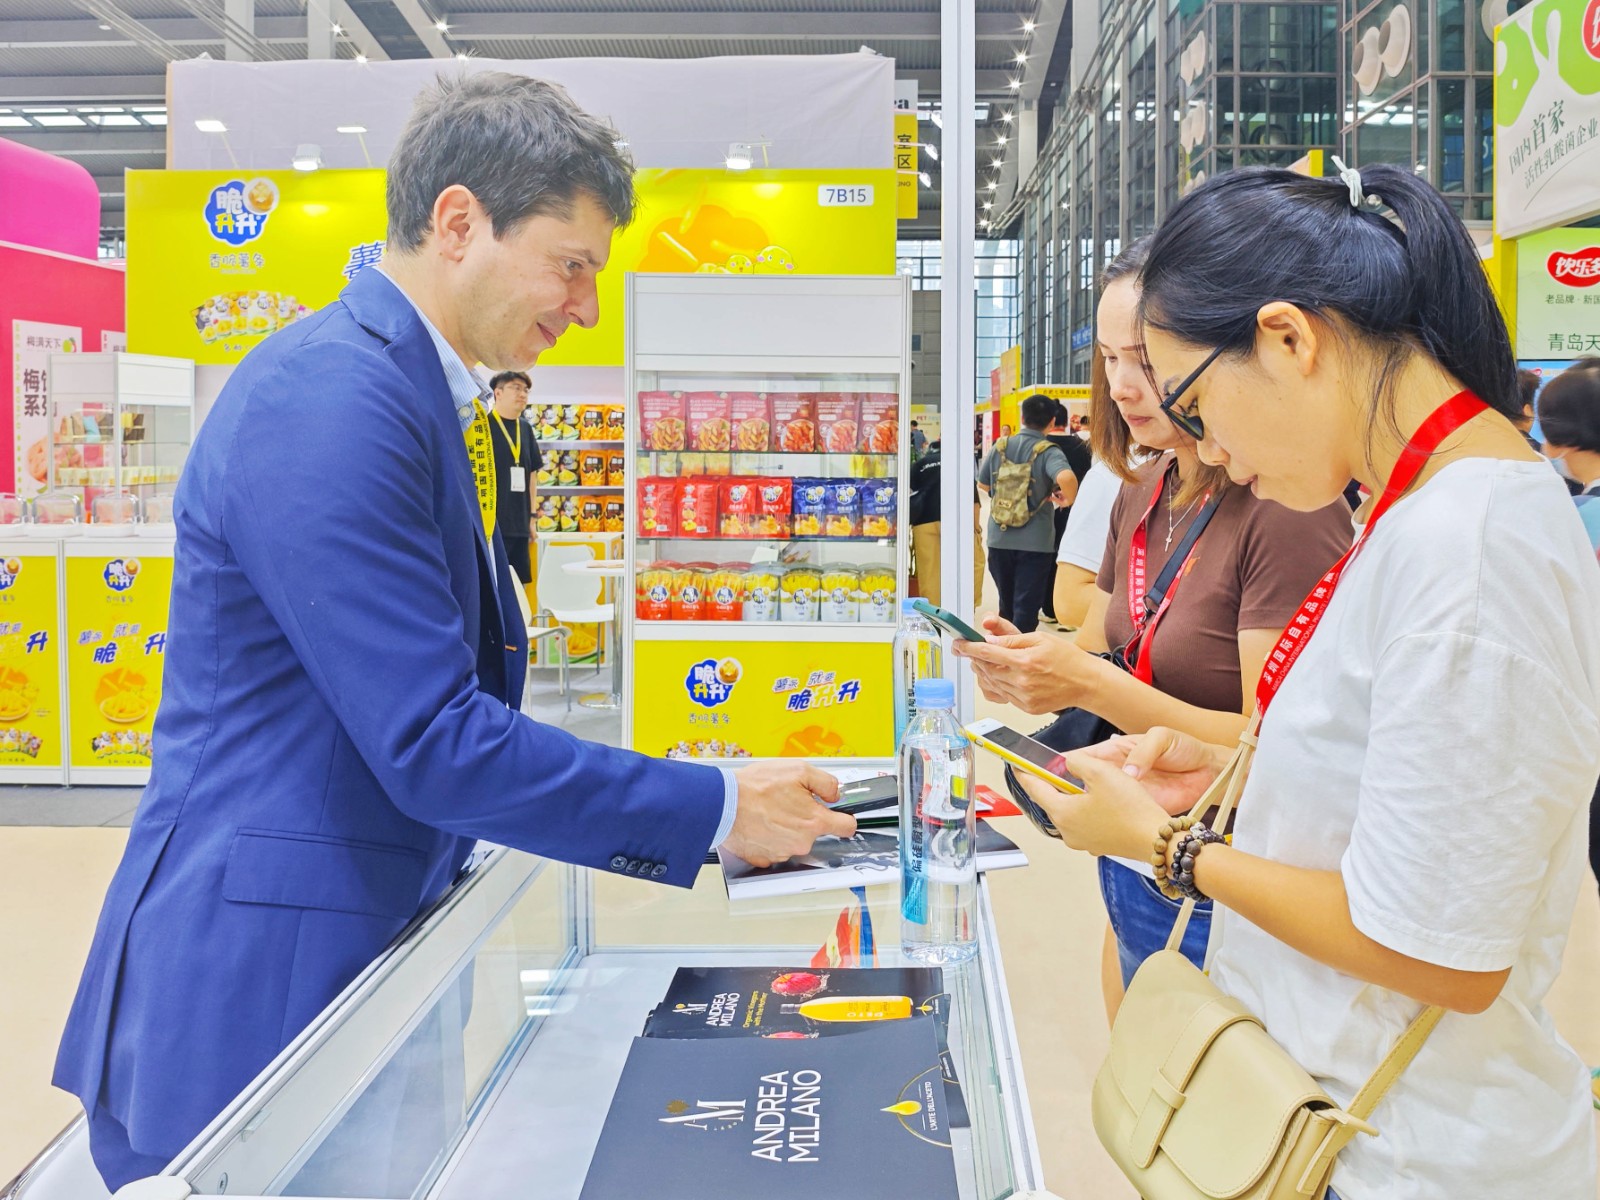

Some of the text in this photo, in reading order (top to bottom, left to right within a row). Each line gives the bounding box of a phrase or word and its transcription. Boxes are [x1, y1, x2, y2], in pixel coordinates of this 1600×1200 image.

[1509, 99, 1565, 175] 国内首家
[1524, 117, 1599, 189] 活性乳酸菌企业
[894, 154, 912, 169] 区
[825, 188, 867, 203] 7B15
[215, 212, 258, 236] 升升
[1548, 333, 1600, 352] 青岛天
[693, 683, 727, 700] 升升
[787, 680, 860, 710] 脆升升
[911, 815, 923, 873] 偏硅酸型
[706, 992, 728, 1026] ANDREA
[719, 992, 740, 1027] MILANO
[751, 1069, 789, 1162] ANDREA
[787, 1068, 822, 1162] MILANO
[926, 1081, 938, 1131] L'ARTE DELL'ACETO
